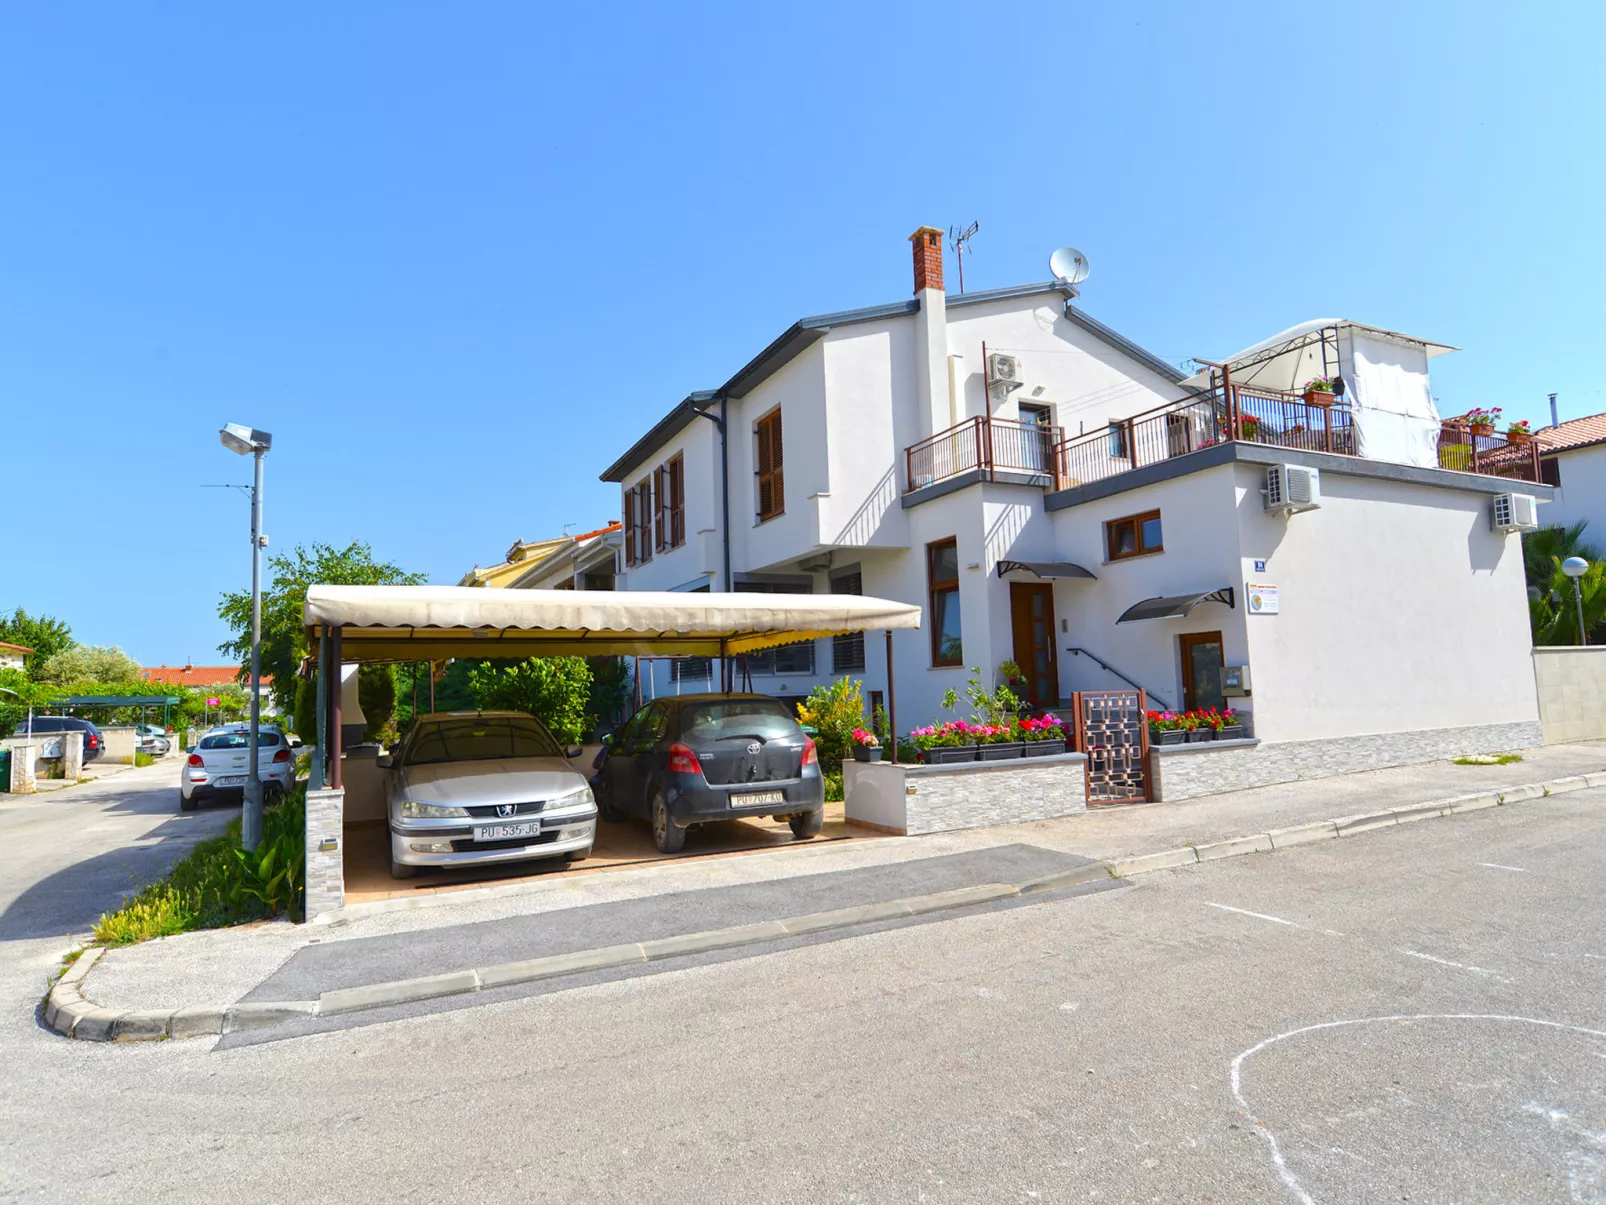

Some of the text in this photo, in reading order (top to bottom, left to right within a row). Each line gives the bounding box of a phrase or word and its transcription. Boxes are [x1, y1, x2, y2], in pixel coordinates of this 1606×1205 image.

[737, 795, 748, 805] PU
[481, 823, 538, 838] PU 535-JG
